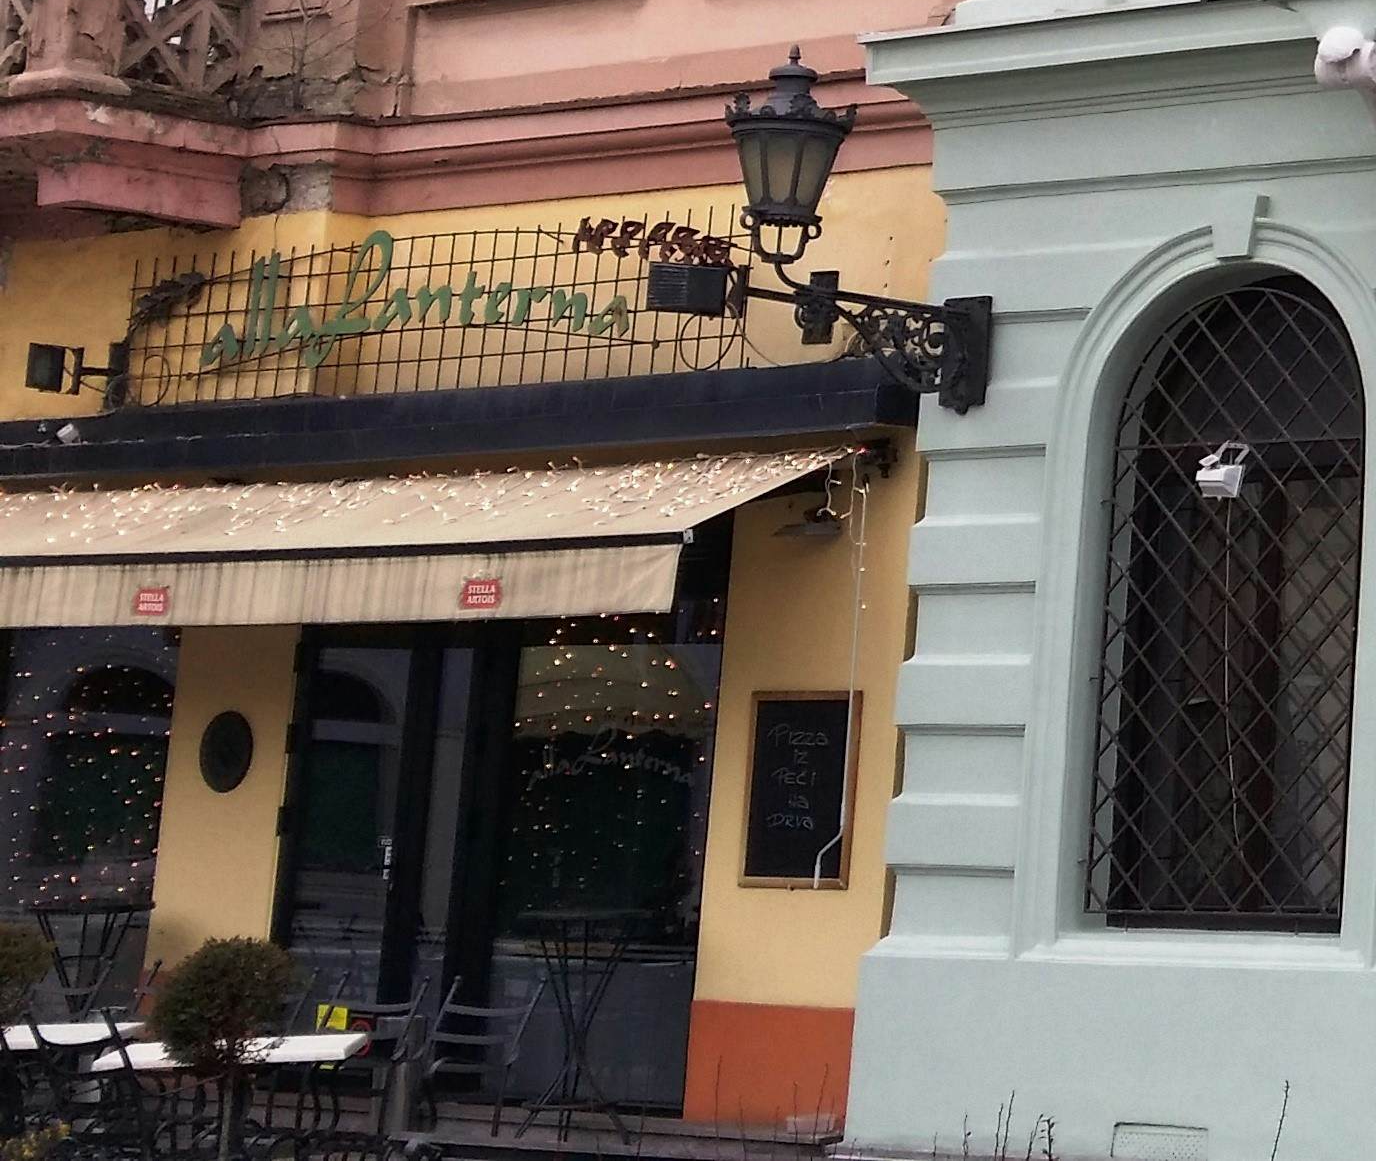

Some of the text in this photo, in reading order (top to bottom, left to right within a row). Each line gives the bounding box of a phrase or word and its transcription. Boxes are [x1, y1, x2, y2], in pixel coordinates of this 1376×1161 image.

[201, 230, 629, 368] alla Lanterna
[468, 585, 496, 594] STELLA
[466, 594, 496, 604] ARTOIS
